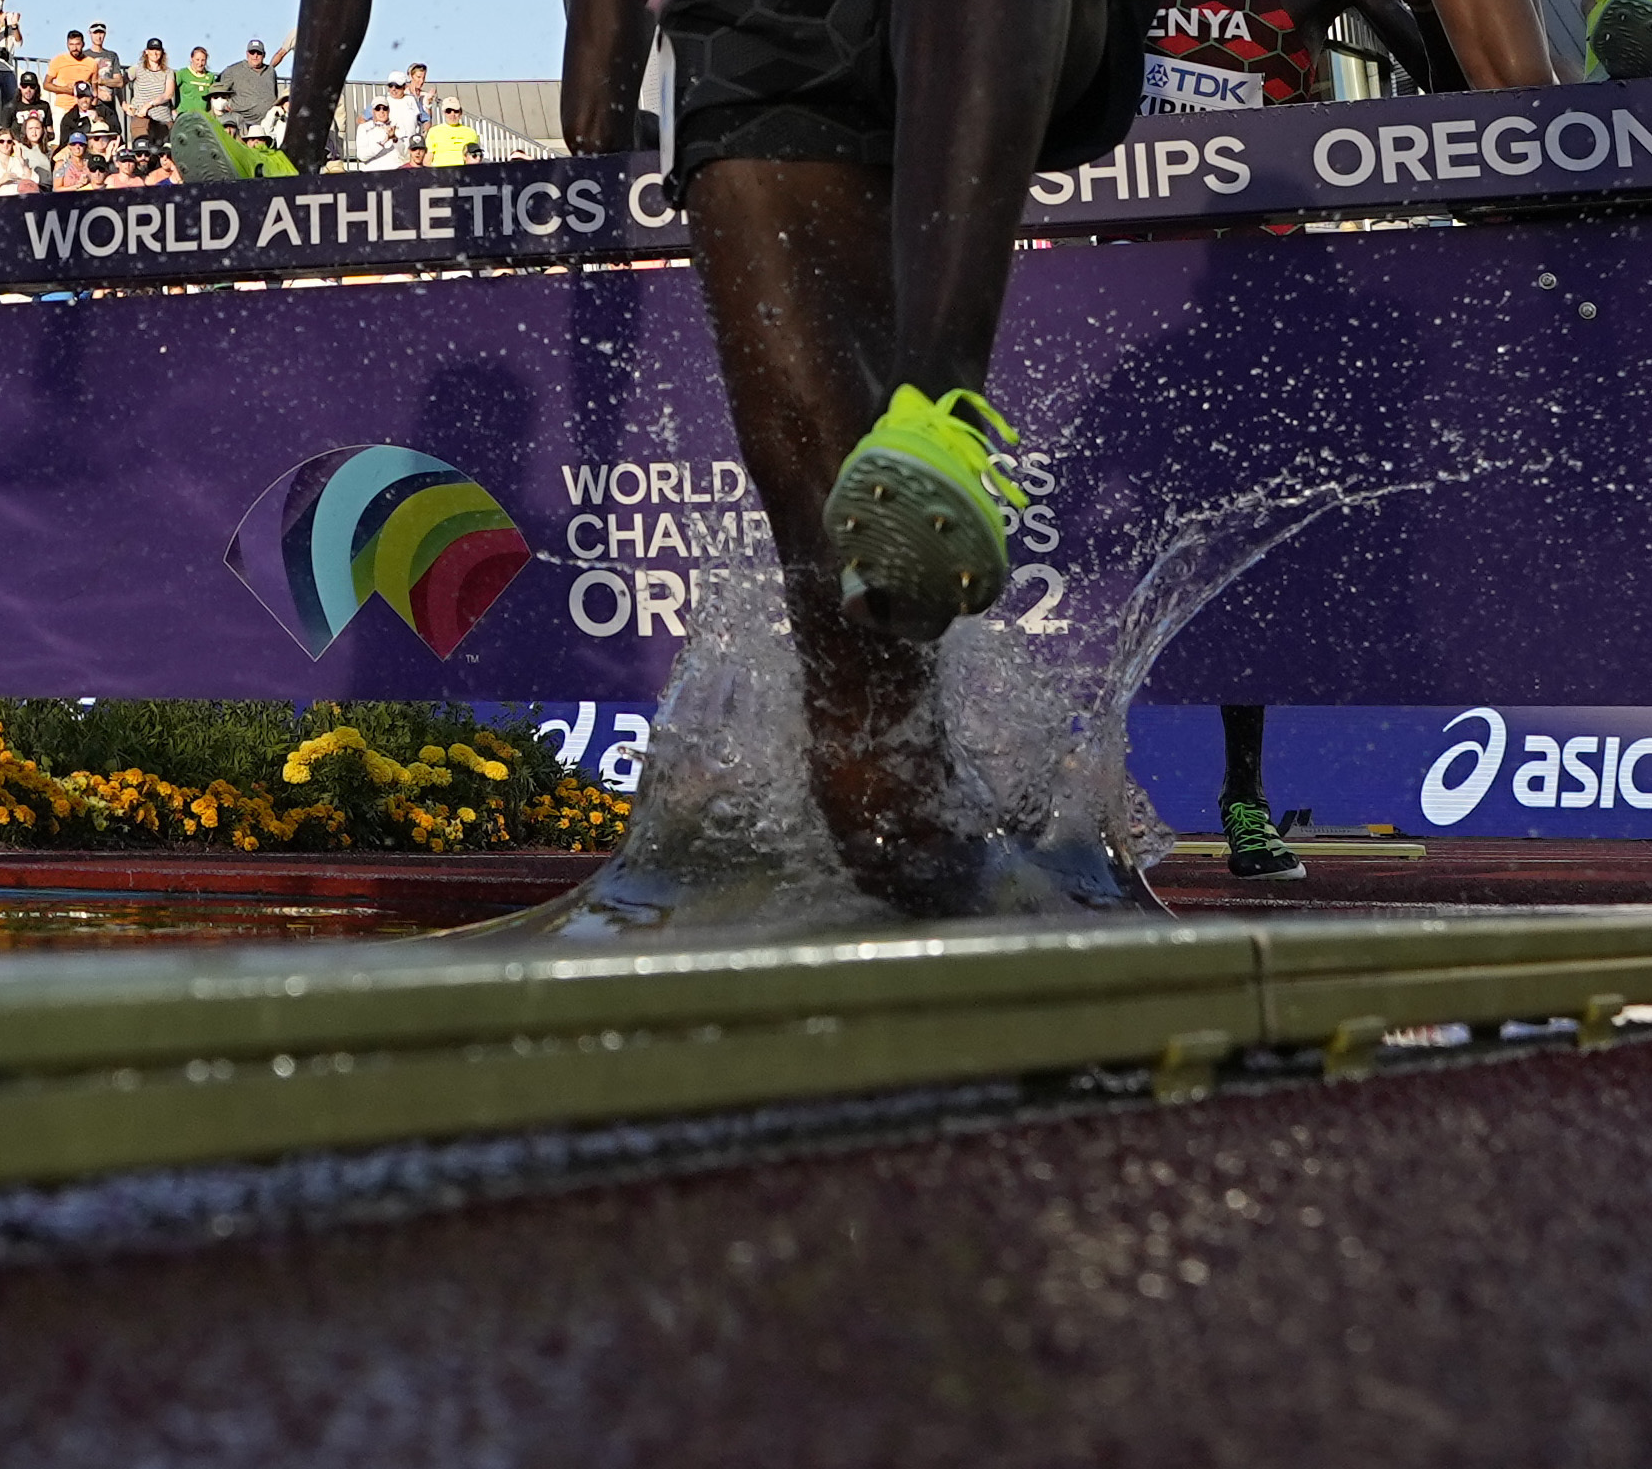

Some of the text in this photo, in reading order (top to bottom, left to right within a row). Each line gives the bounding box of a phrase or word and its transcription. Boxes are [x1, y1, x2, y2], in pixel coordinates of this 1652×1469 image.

[1170, 66, 1249, 105] TDK
[24, 200, 239, 262] WORLD
[256, 176, 605, 249] ATHLETICS
[561, 460, 748, 507] WORLD
